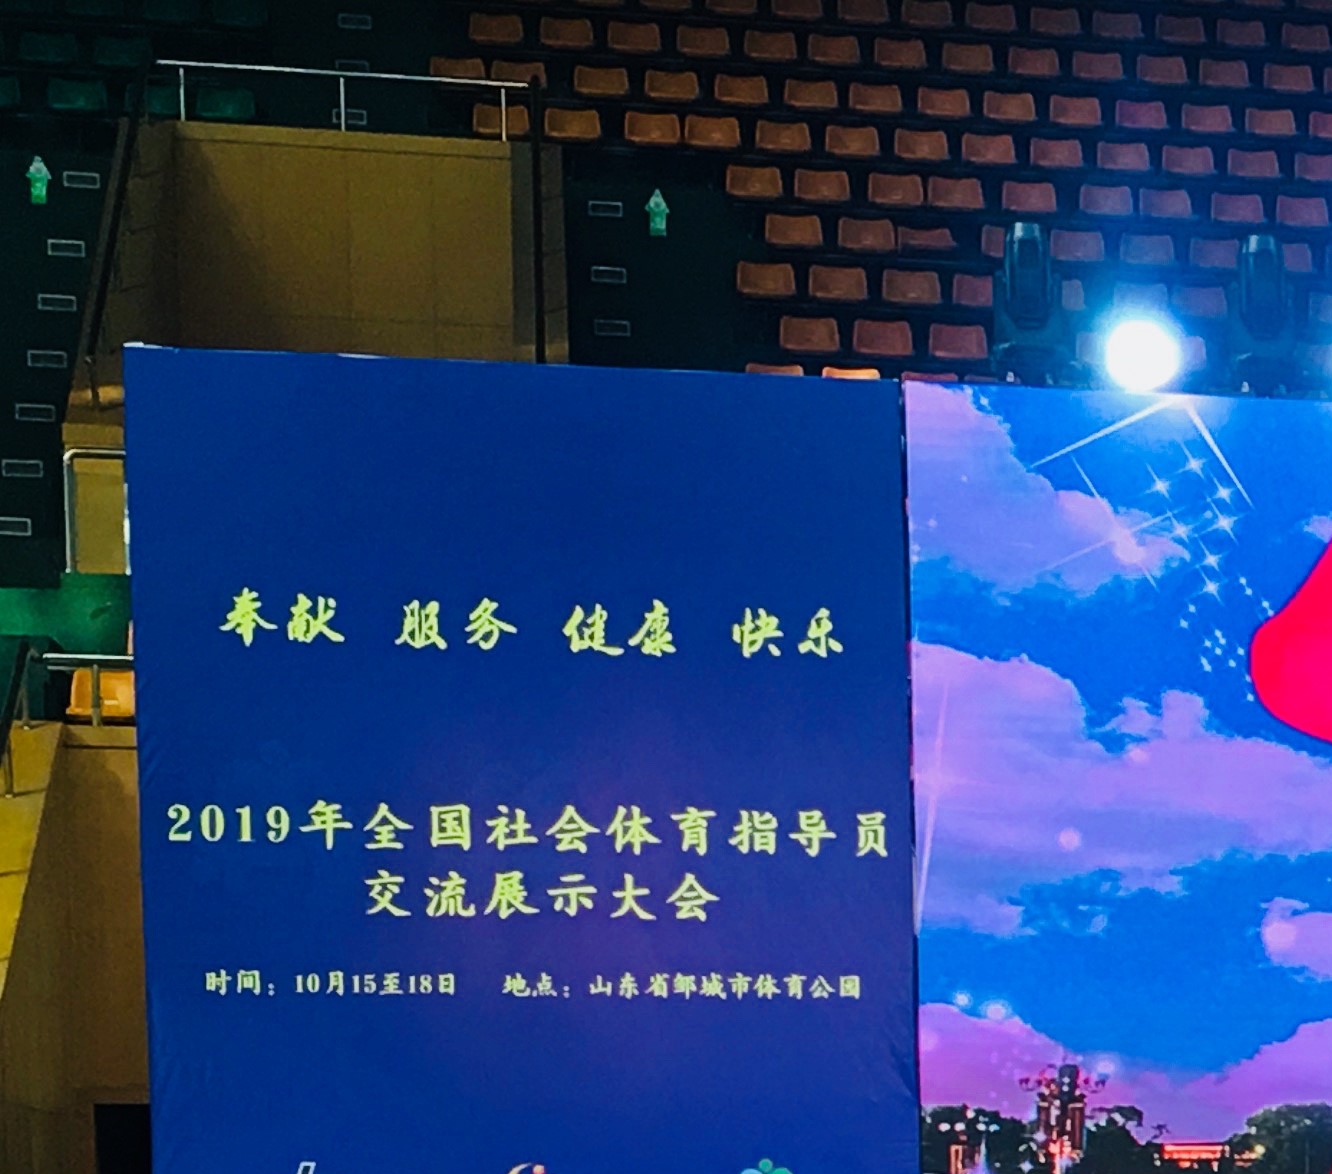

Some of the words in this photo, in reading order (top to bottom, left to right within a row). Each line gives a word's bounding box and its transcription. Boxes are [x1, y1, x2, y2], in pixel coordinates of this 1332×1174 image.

[219, 586, 346, 647] 奉献
[394, 597, 518, 651] 服务
[562, 598, 677, 658] 健康
[732, 607, 845, 659] 快乐
[167, 799, 889, 859] 2019年全国社会体育指导员
[364, 869, 721, 923] 交流展示大会
